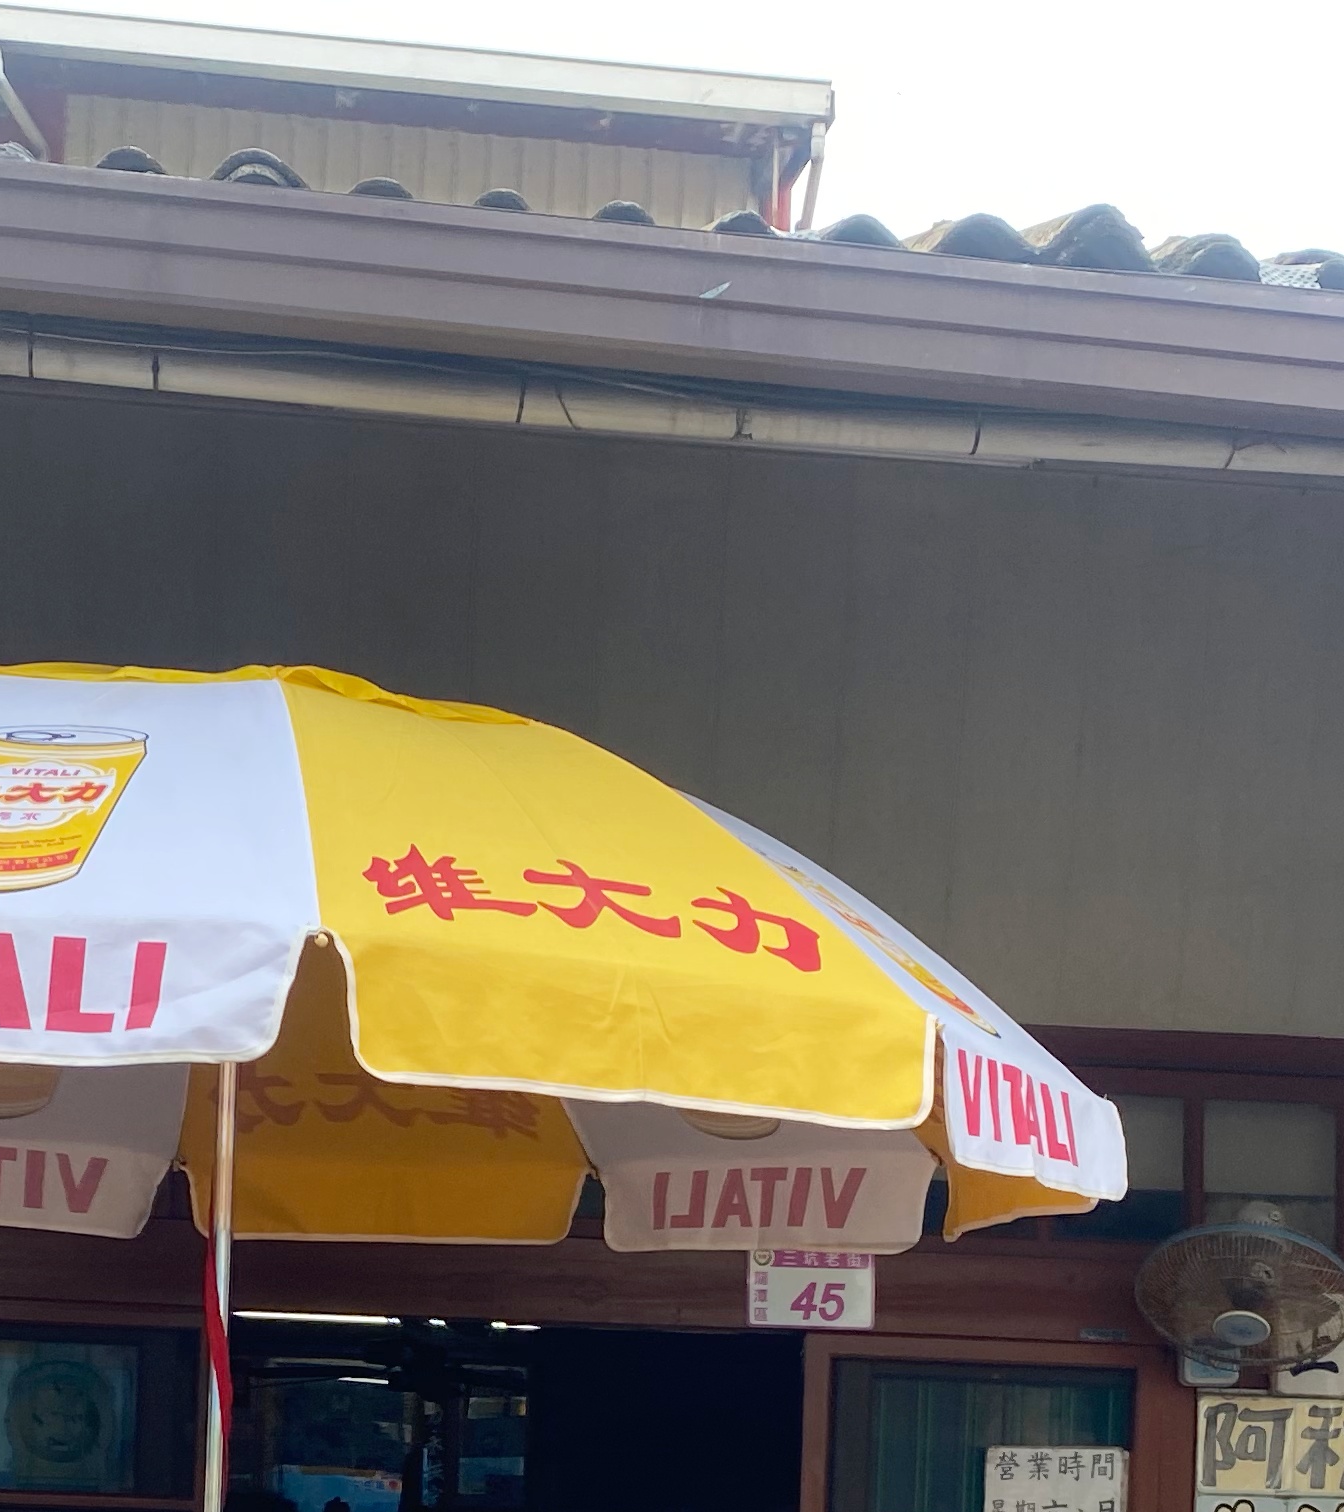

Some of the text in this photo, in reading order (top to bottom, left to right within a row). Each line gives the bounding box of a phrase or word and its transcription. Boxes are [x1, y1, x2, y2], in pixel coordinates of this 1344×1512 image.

[11, 767, 81, 777] VITALI
[957, 1048, 1079, 1168] VITALI
[790, 1282, 846, 1322] 45
[994, 1451, 1115, 1481] 營業時間
